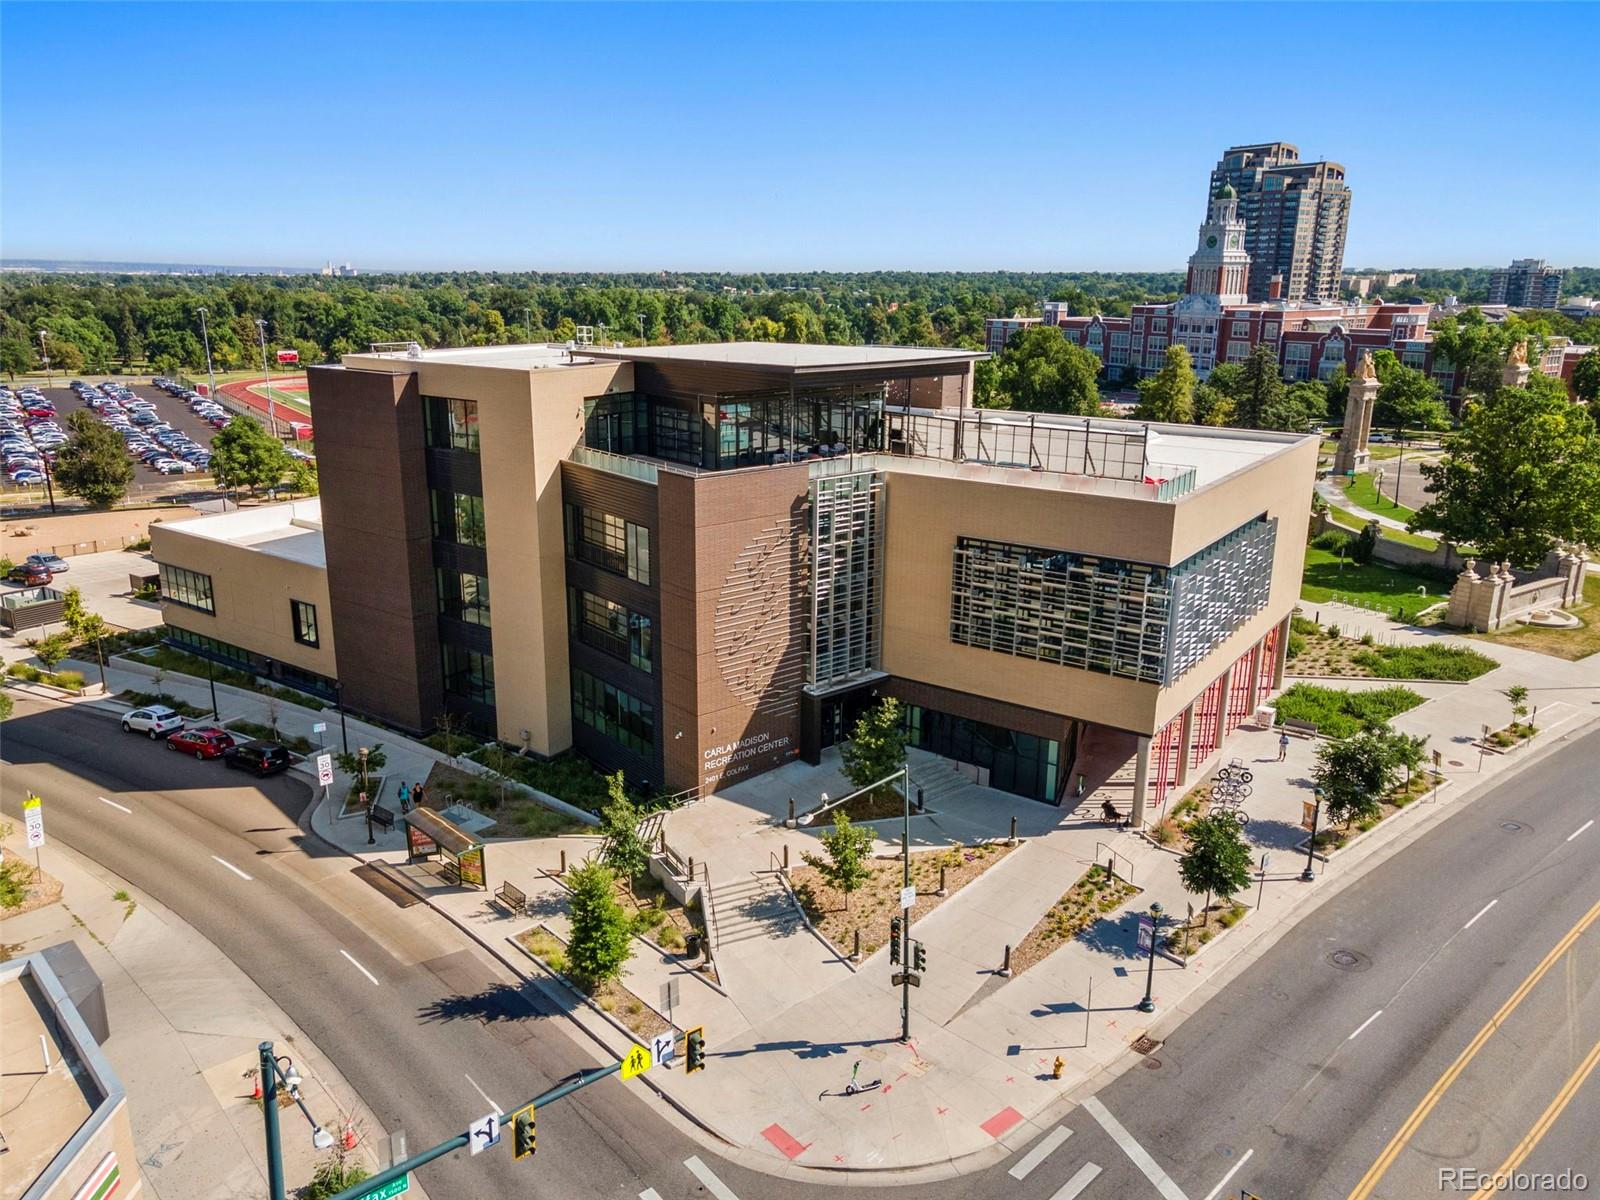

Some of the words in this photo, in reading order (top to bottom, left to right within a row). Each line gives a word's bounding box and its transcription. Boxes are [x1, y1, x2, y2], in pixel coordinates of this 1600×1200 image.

[704, 744, 732, 759] CARLA
[732, 732, 770, 750] MADISON
[704, 747, 756, 771] RECREATION
[757, 737, 789, 753] CENTER
[705, 775, 719, 784] 2401
[726, 764, 750, 777] COLFAX
[29, 822, 41, 831] 30
[392, 1180, 402, 1188] Ave
